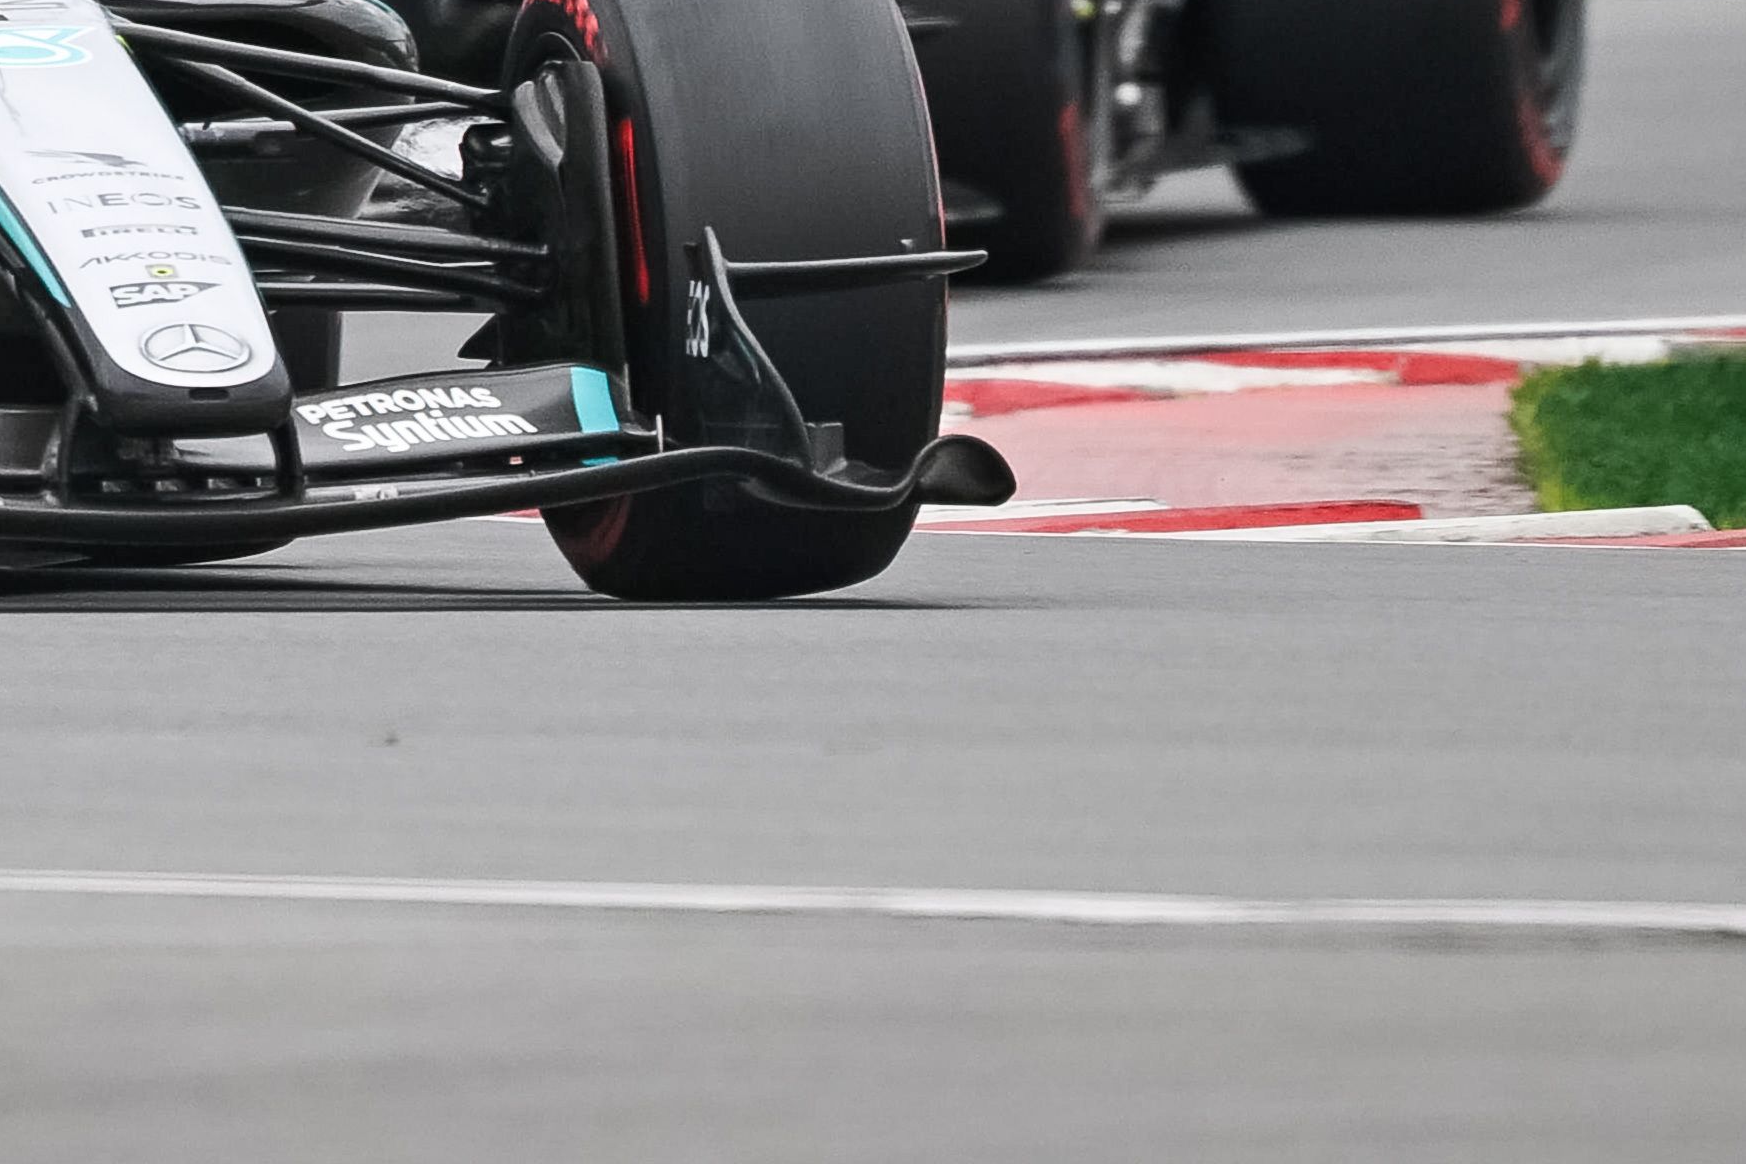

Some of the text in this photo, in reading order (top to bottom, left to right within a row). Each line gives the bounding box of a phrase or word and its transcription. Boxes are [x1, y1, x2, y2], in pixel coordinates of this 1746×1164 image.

[46, 192, 202, 215] INEOS
[110, 282, 208, 308] SAP
[296, 385, 502, 427] PETRONAS
[329, 412, 538, 456] Syntium
